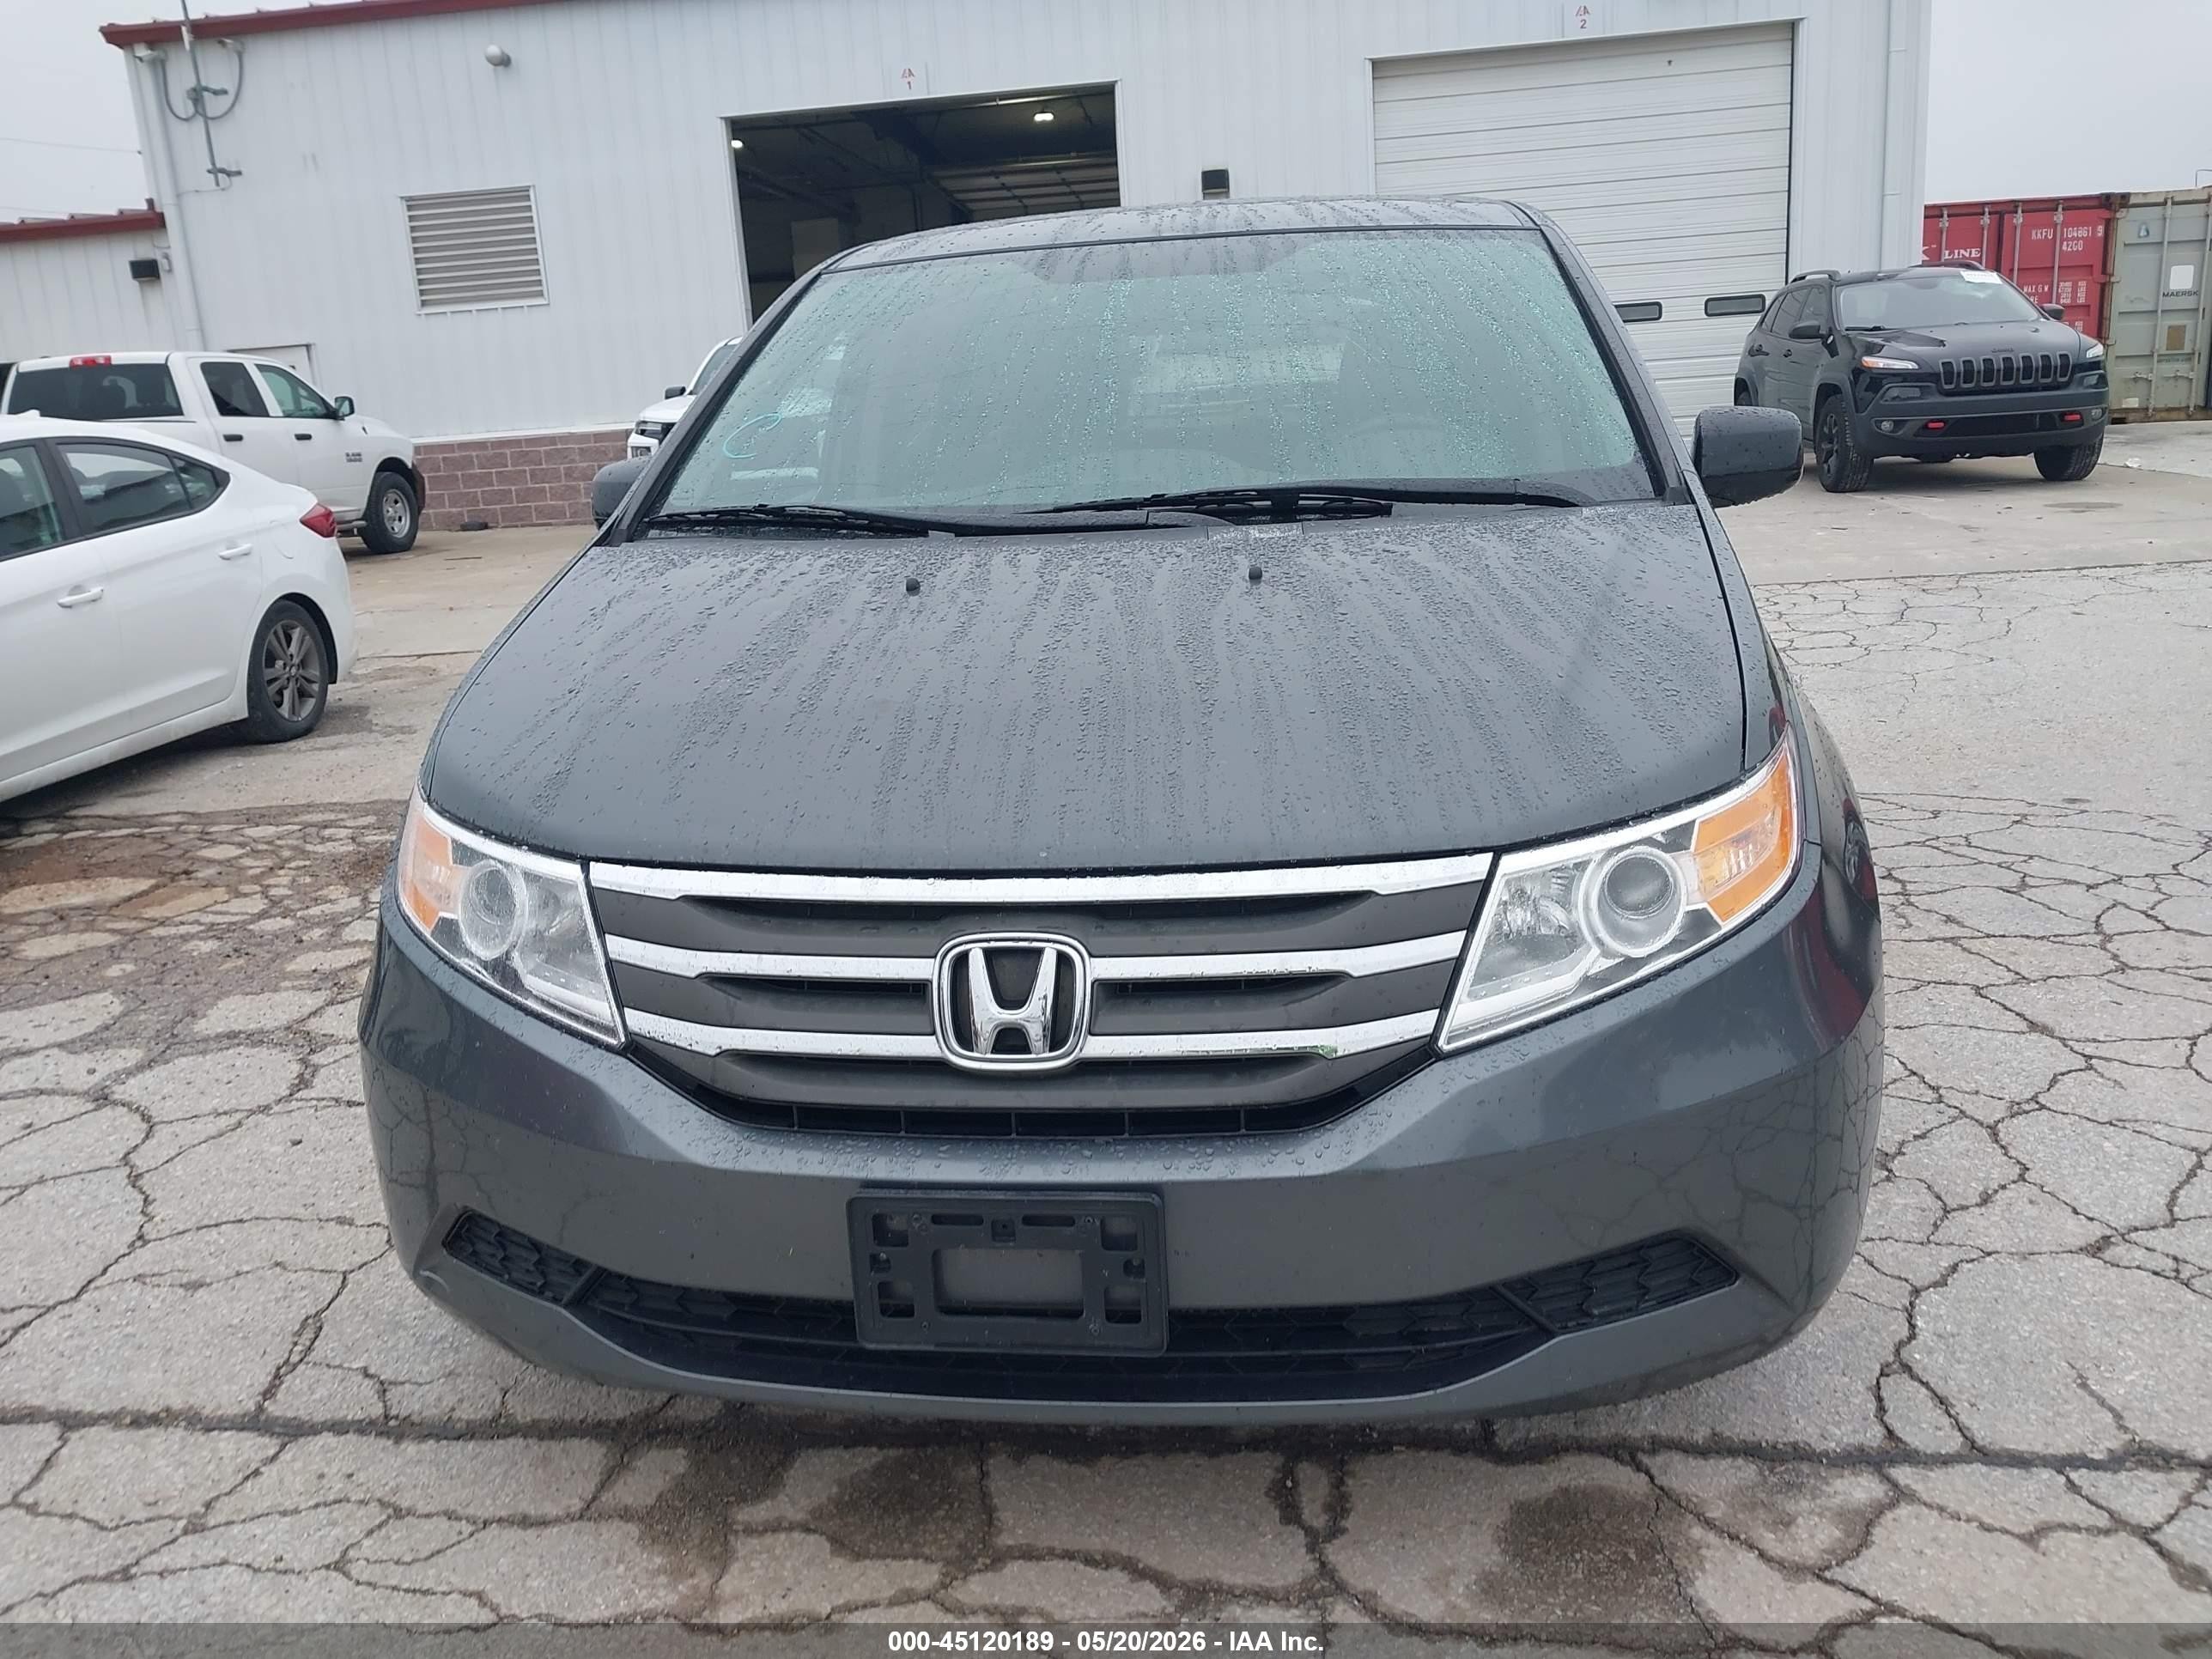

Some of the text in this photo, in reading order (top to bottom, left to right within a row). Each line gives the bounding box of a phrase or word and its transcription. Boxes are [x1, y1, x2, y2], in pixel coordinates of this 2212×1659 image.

[1580, 19, 1587, 29] 2
[907, 81, 912, 90] 1
[2032, 228, 2053, 240] KKFU
[1944, 248, 1981, 259] LINE
